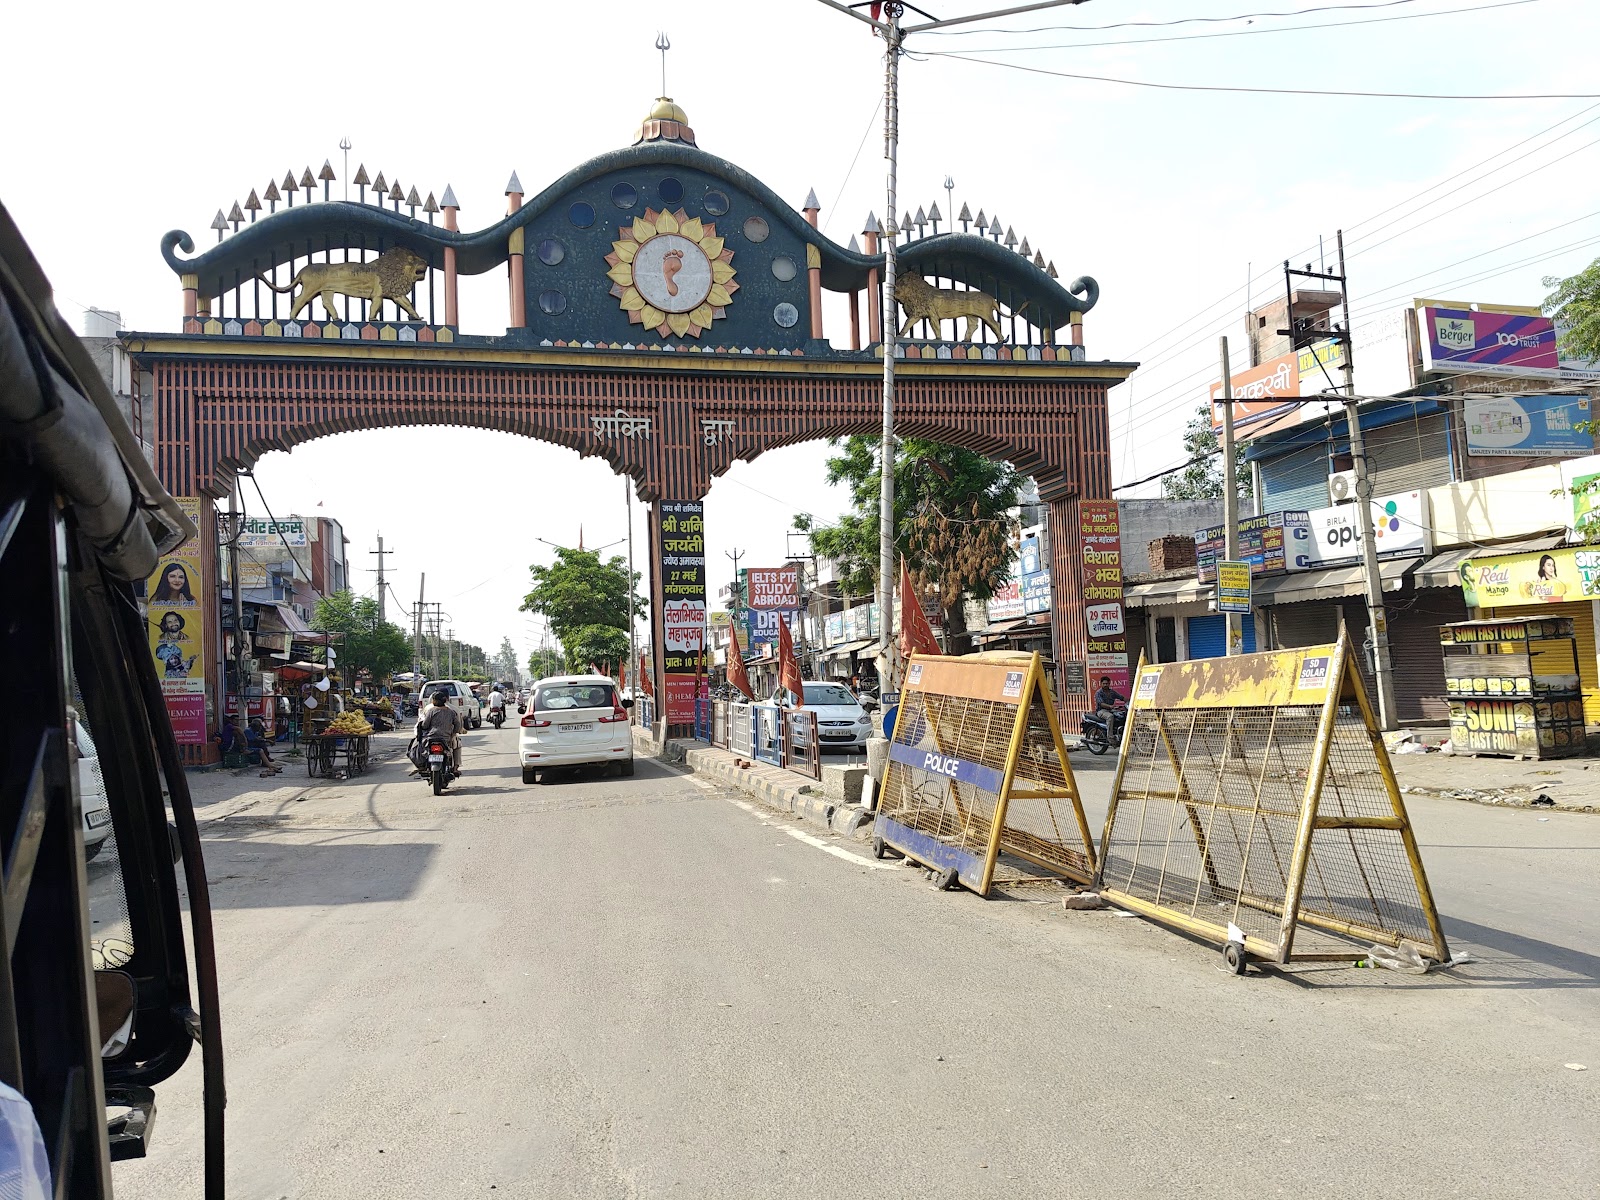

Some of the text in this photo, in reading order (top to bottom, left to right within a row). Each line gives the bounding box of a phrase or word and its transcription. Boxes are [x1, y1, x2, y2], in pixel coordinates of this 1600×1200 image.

[1440, 328, 1473, 344] Berger
[1496, 332, 1519, 346] 100
[590, 409, 736, 446] शक्ति द्वार
[1547, 420, 1570, 431] White
[662, 502, 702, 513] जय श्री शनिदेव
[662, 514, 704, 533] श्री शनि
[1092, 514, 1107, 523] 2025
[1286, 513, 1309, 521] GOYA
[1327, 516, 1347, 526] BIRLA
[1094, 522, 1118, 533] नवरात्रि
[1207, 526, 1226, 540] GOYA
[1237, 517, 1268, 532] MPUTER
[1327, 525, 1376, 547] opu
[664, 535, 703, 552] जयंती
[1083, 546, 1119, 564] विशाल
[670, 568, 697, 582] 27 मई
[752, 572, 777, 583] IELTS
[1096, 568, 1120, 582] भव्य
[664, 582, 704, 594] मंगलवार
[755, 584, 793, 594] STUDY
[1085, 583, 1122, 600] शोभायात्रा
[1486, 586, 1509, 596] Mango
[753, 595, 796, 606] ABROAD
[666, 603, 704, 623] तेलाभिषेक
[1090, 606, 1119, 621] 29 मार्च
[757, 611, 799, 629] DREA
[1093, 621, 1118, 632] शनिवार
[668, 627, 703, 649] महापूजन
[1455, 624, 1525, 642] SONI FAST FOOD
[1088, 640, 1107, 652] दोपहर
[1114, 639, 1126, 652] बजे
[665, 657, 682, 669] प्रातः
[684, 657, 692, 668] 10
[1309, 659, 1320, 668] SD
[1011, 673, 1018, 681] SD
[1301, 667, 1326, 678] SOLAR
[1005, 680, 1021, 689] SOLAR
[885, 694, 900, 702] KEE
[1465, 700, 1515, 732] SONI
[1469, 731, 1517, 750] FAST FOOD
[924, 753, 960, 777] POLICE
